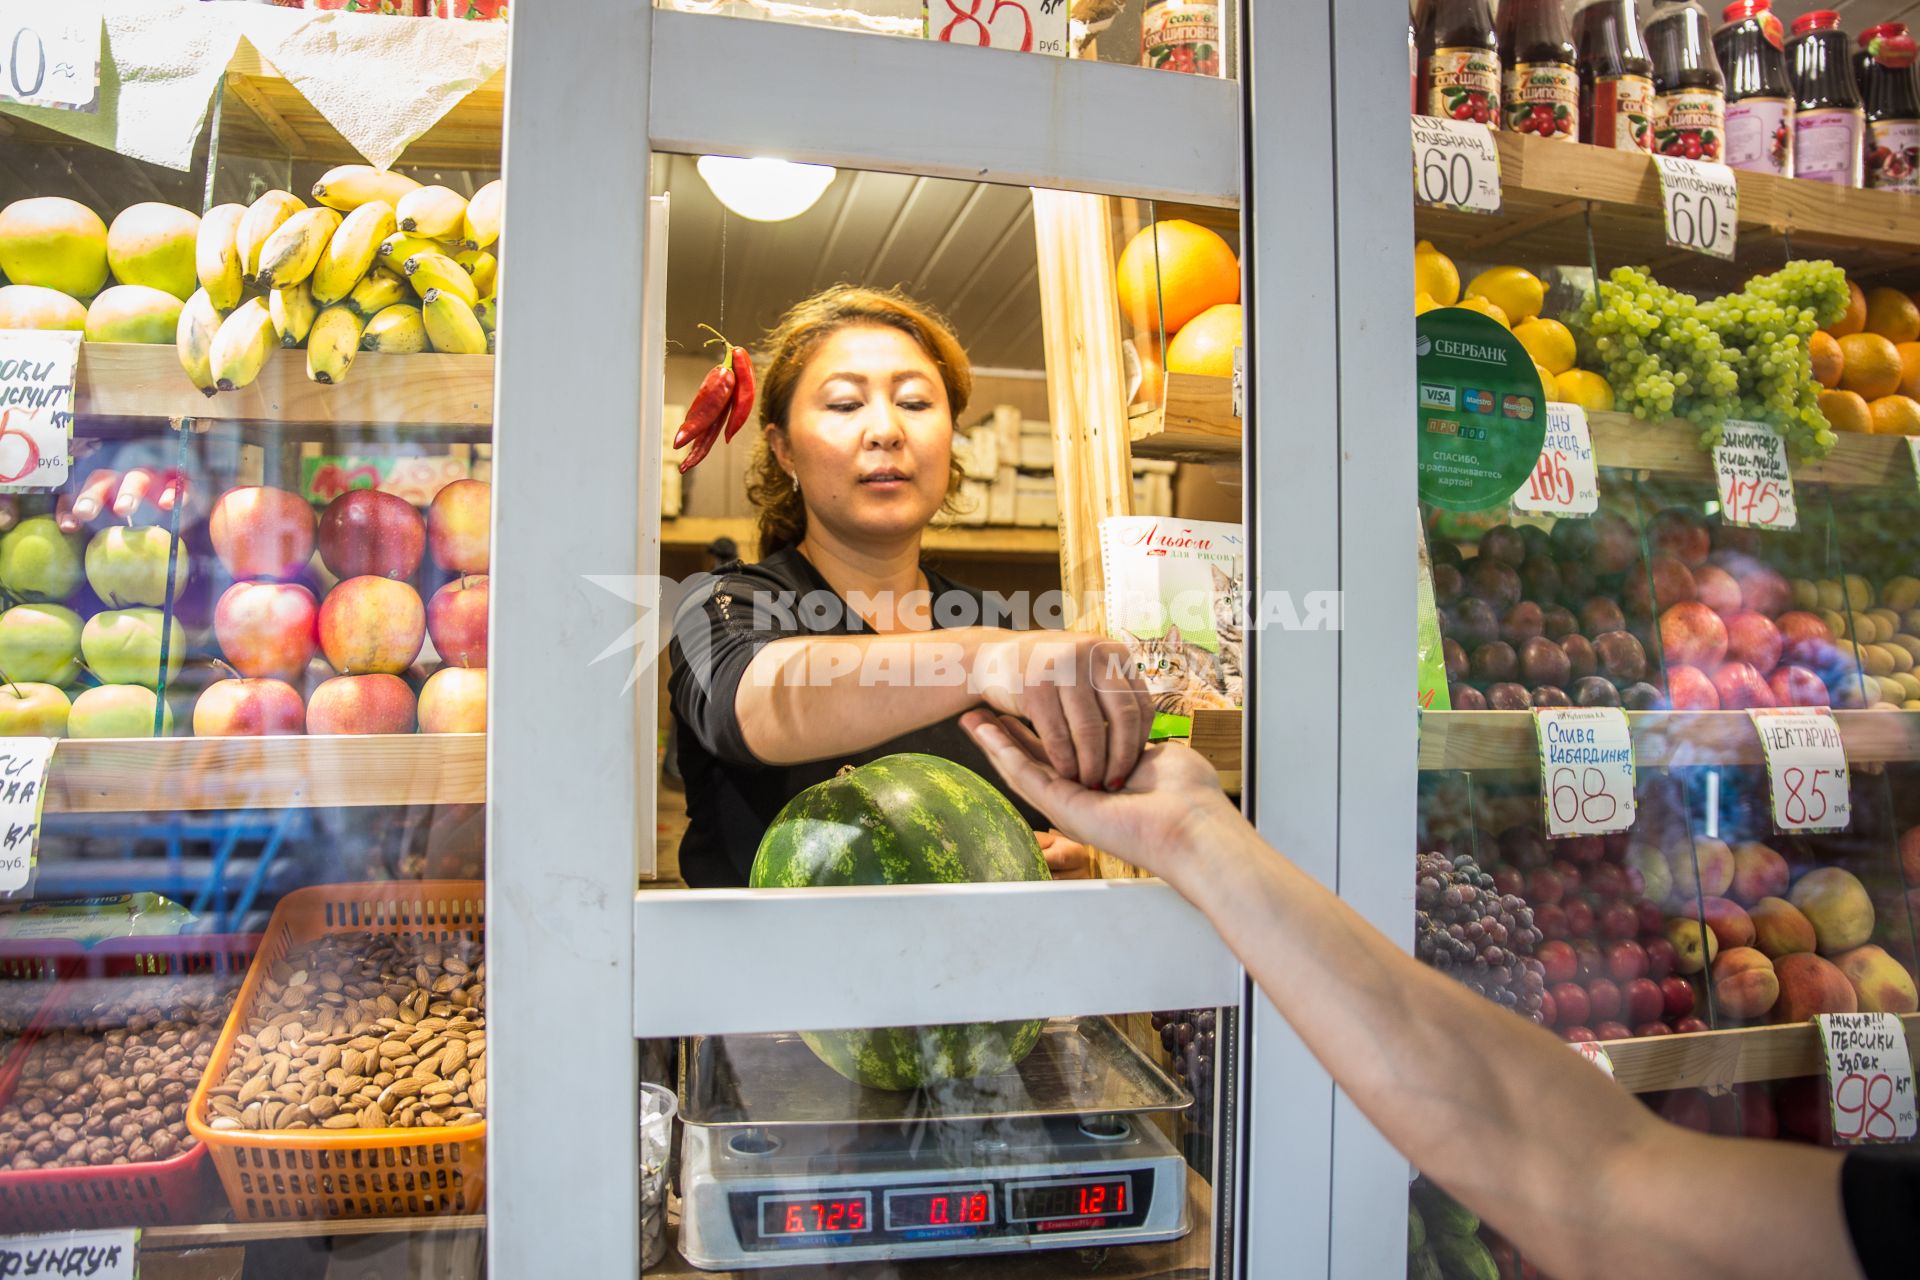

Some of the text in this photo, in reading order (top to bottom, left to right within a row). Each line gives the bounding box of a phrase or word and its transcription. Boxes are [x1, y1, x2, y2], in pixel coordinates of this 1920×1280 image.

[1039, 39, 1062, 52] руб.
[1411, 116, 1451, 132] СОК
[1664, 158, 1701, 176] СОК
[1435, 339, 1507, 362] СБЕРБАНК
[1425, 388, 1451, 402] VISA
[1466, 396, 1492, 406] Maestro
[38, 455, 64, 469] руб.
[1433, 451, 1480, 466] СПАСИБО,
[1426, 464, 1502, 479] расплачиваетесь
[1438, 477, 1473, 488] картой!
[1727, 479, 1780, 527] 175
[1764, 727, 1840, 750] НЕКТАРИН
[1834, 769, 1846, 779] кг
[1552, 767, 1617, 824] 68
[1784, 767, 1830, 824] 85
[1834, 804, 1848, 814] руб.
[1831, 1031, 1894, 1051] ПЕРСИКИ
[1896, 1076, 1910, 1095] кг
[1836, 1073, 1897, 1141] 98
[1899, 1112, 1914, 1123] руб.
[929, 1193, 987, 1224] 0.18
[784, 1202, 864, 1233] 6.725
